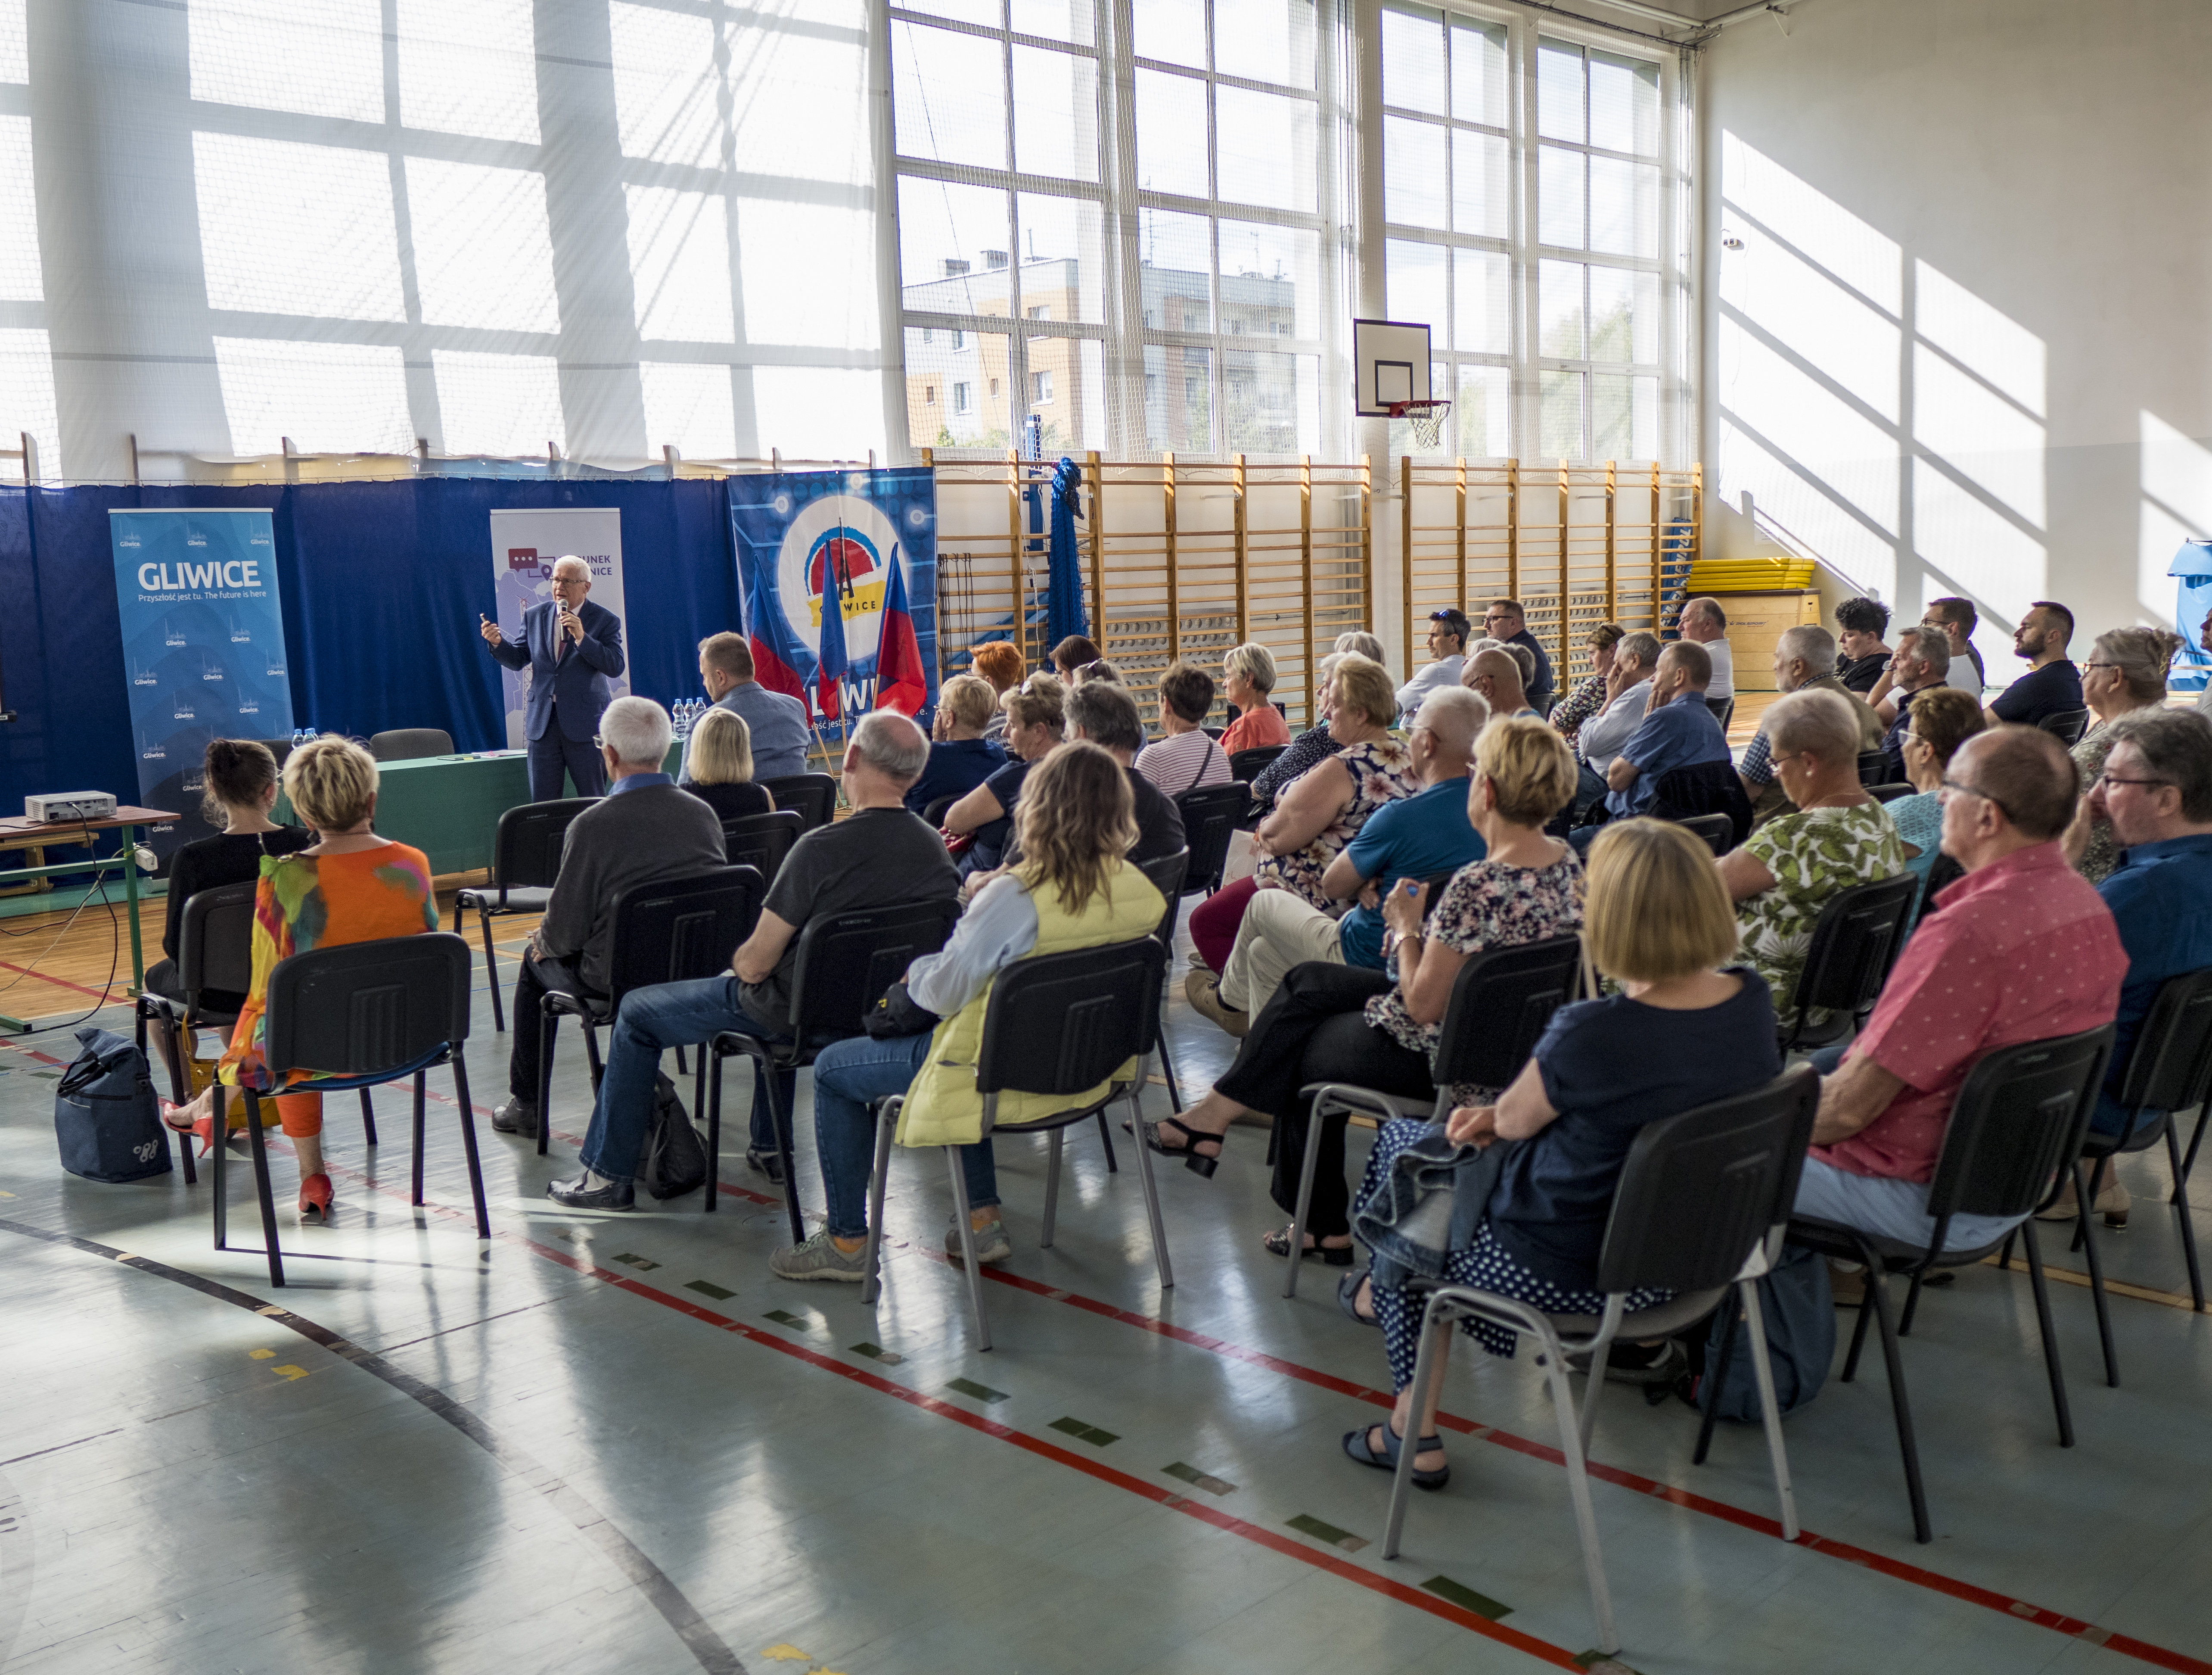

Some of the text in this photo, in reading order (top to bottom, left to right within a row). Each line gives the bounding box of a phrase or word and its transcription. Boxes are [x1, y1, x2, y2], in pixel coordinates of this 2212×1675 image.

[138, 560, 261, 591] GLIWICE
[139, 593, 176, 603] Przyszłość
[177, 593, 191, 602] jest
